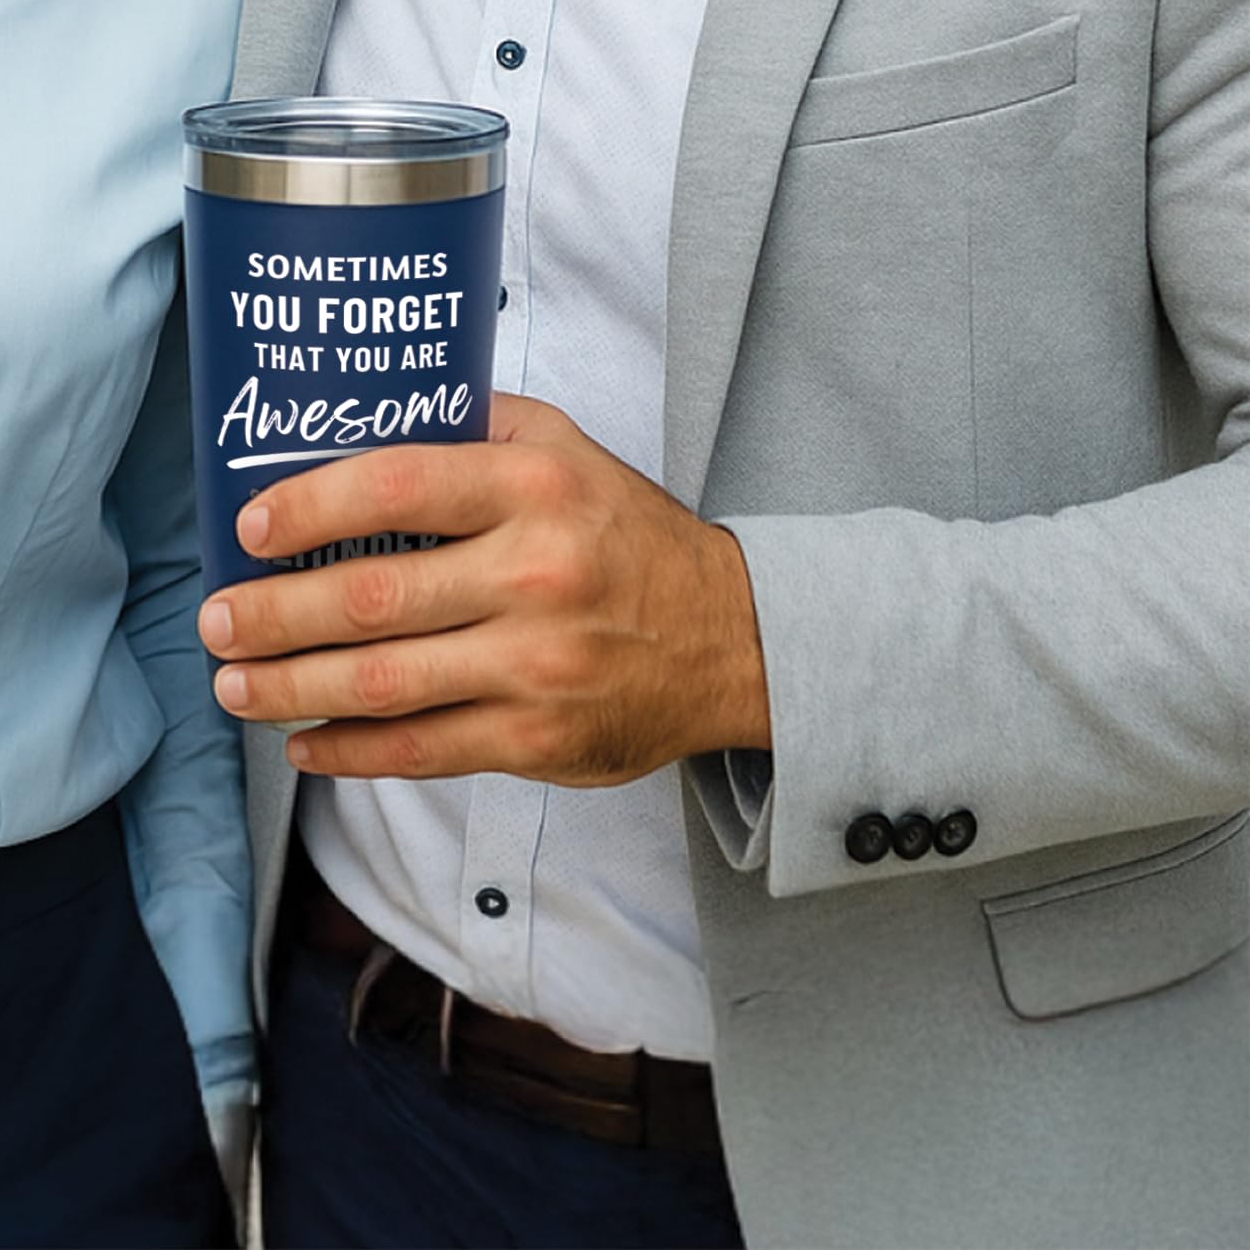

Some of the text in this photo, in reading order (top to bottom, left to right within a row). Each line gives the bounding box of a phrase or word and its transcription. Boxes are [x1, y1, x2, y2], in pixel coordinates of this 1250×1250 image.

[248, 252, 448, 282] SOMETIMES
[230, 291, 464, 335] YOU FORGET
[253, 341, 449, 373] THAT YOU ARE
[217, 375, 473, 448] Awesome
